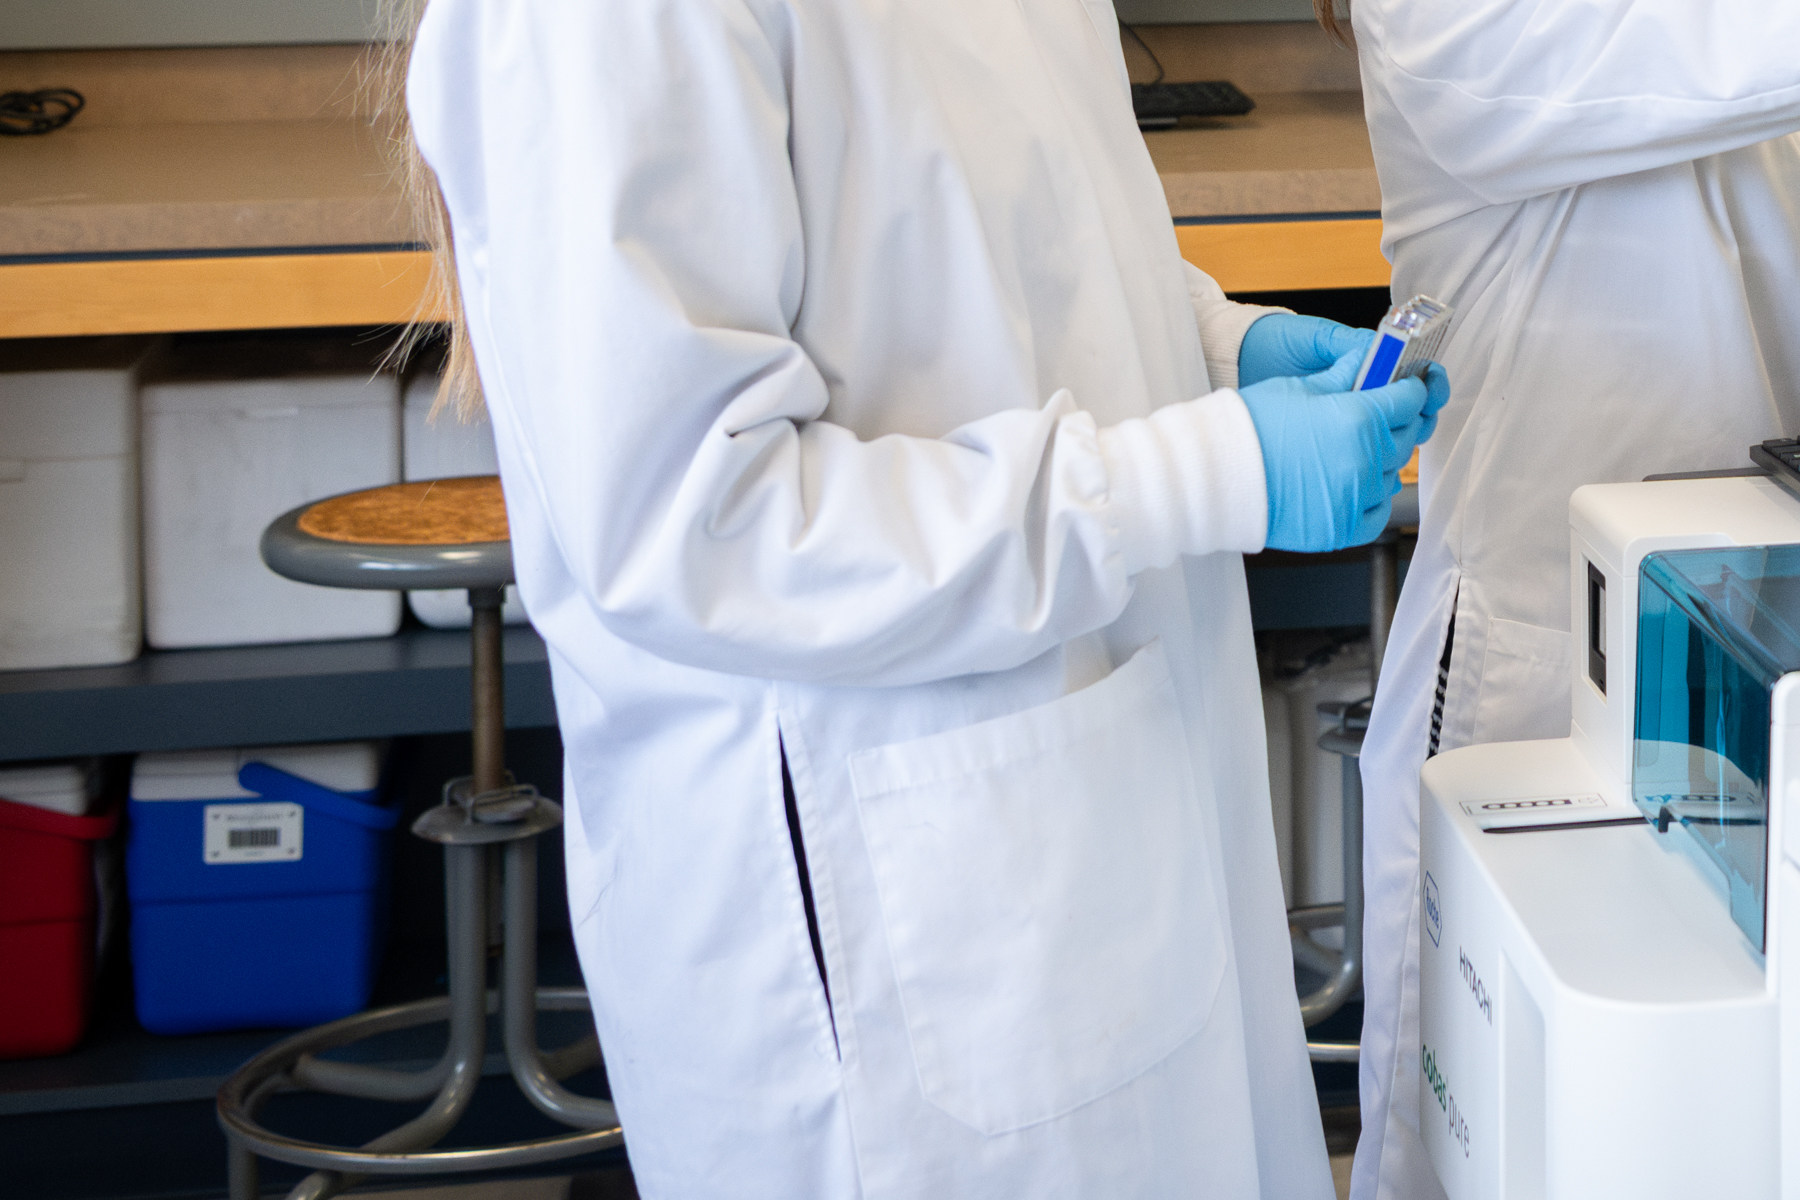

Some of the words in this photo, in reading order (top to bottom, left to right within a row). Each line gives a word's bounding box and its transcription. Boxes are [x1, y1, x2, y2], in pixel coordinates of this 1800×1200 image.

[1426, 886, 1439, 930] Roche
[1459, 945, 1493, 1027] HITACHI
[1422, 1044, 1447, 1113] cobas
[1449, 1094, 1470, 1159] pure
